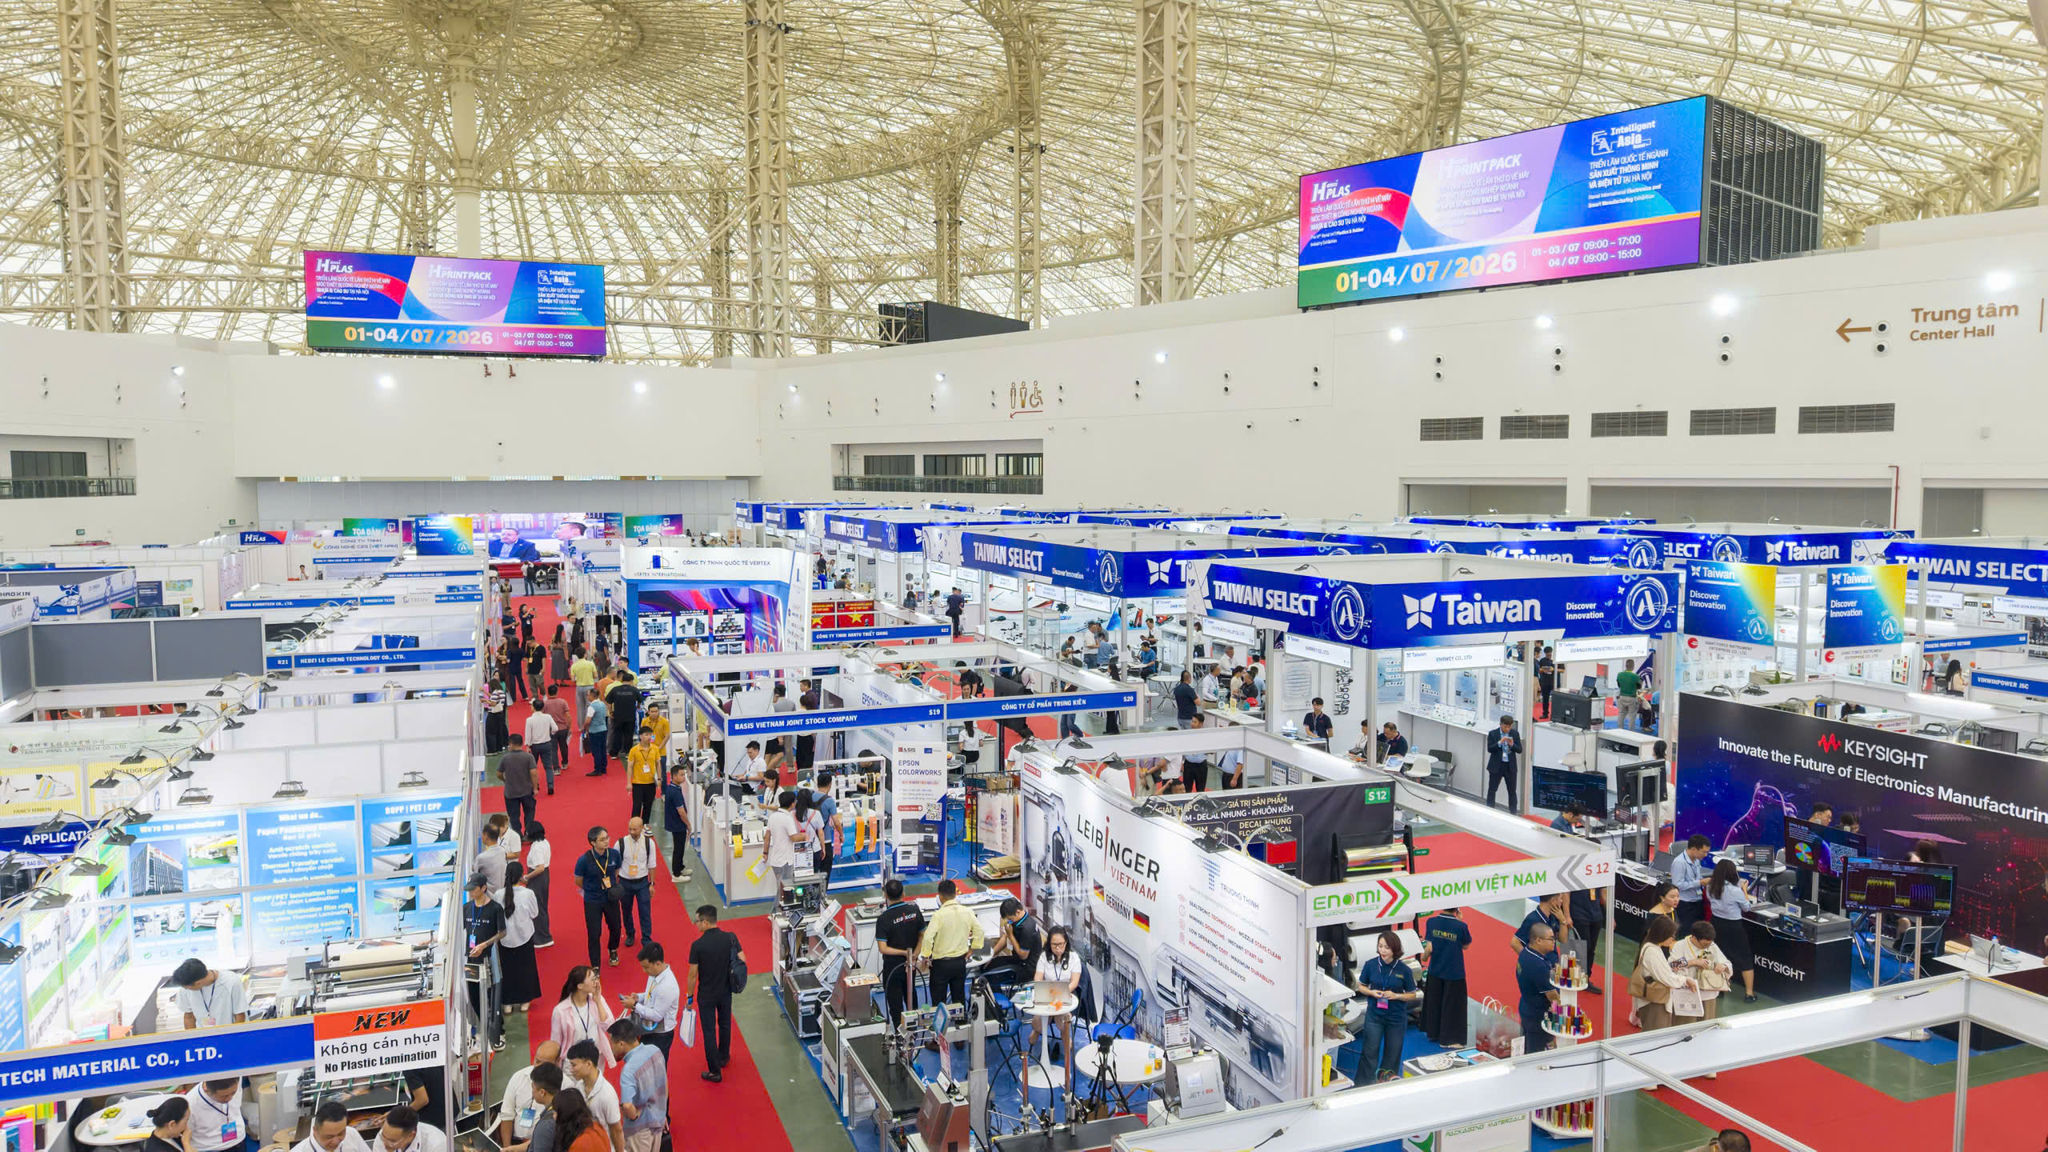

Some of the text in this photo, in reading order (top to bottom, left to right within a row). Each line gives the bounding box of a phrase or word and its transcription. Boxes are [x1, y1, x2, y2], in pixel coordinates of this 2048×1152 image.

[1583, 238, 1608, 251] 09:00
[1617, 234, 1641, 248] 17:00
[1583, 251, 1608, 264] 09:00
[1617, 247, 1641, 261] 15:00
[1911, 302, 2019, 324] Trung tâm
[1910, 325, 1995, 342] Center Hall
[973, 542, 1044, 572] TAIWAN SELECT
[1510, 548, 1574, 564] Taiwan
[1664, 541, 1702, 559] ELECT
[1785, 541, 1841, 561] Taiwan
[1702, 565, 1736, 580] Taiwan
[1843, 572, 1873, 585] Taiwan
[1975, 561, 2048, 583] SELECT
[1212, 580, 1319, 617] TAIWAN SELECT
[1689, 590, 1720, 601] Discover
[1830, 599, 1858, 608] Discover
[1440, 593, 1542, 626] Taiwan
[1566, 602, 1597, 611] Discover
[1689, 599, 1727, 611] Innovation
[1829, 608, 1863, 619] Innovation
[1566, 610, 1605, 621] Innovation
[346, 654, 381, 662] TECHNOLOGY
[928, 708, 941, 716] S19
[1001, 702, 1018, 711] CÔNG
[1027, 700, 1036, 709] CỔ
[1036, 700, 1052, 709] PHẦN
[1053, 699, 1072, 707] TRUNG
[1072, 697, 1087, 706] KIÊN
[734, 715, 858, 730] BASIS VIETNAM JOINT STOCK COMPANY
[898, 759, 920, 767] EPSON
[1844, 740, 1929, 771] KEYSIGHT
[897, 768, 943, 776] COLORWORKS
[1718, 737, 2048, 824] Innovate the Future of Electronics Manufacturin
[1227, 793, 1288, 810] GIÁ TRỊ SẢN PHẨM
[1368, 789, 1388, 802] S 12
[1221, 810, 1247, 820] NHUNG
[1252, 806, 1277, 817] KHUÔN
[1239, 818, 1262, 829] DECAL
[1584, 862, 1610, 876] S 12
[1110, 865, 1157, 902] VIETNAM
[1421, 870, 1547, 900] ENOMI VIỆT NAM
[1106, 894, 1131, 921] GERMANY
[1613, 899, 1649, 919] EYSIGHT
[1754, 954, 1806, 982] KEYSIGHT
[351, 1009, 410, 1032] NEW
[320, 1031, 441, 1058] Không cán nhựa
[0, 1046, 224, 1087] TECH MATERIAL CO., LTD.
[324, 1049, 438, 1073] No Plastic Lamination
